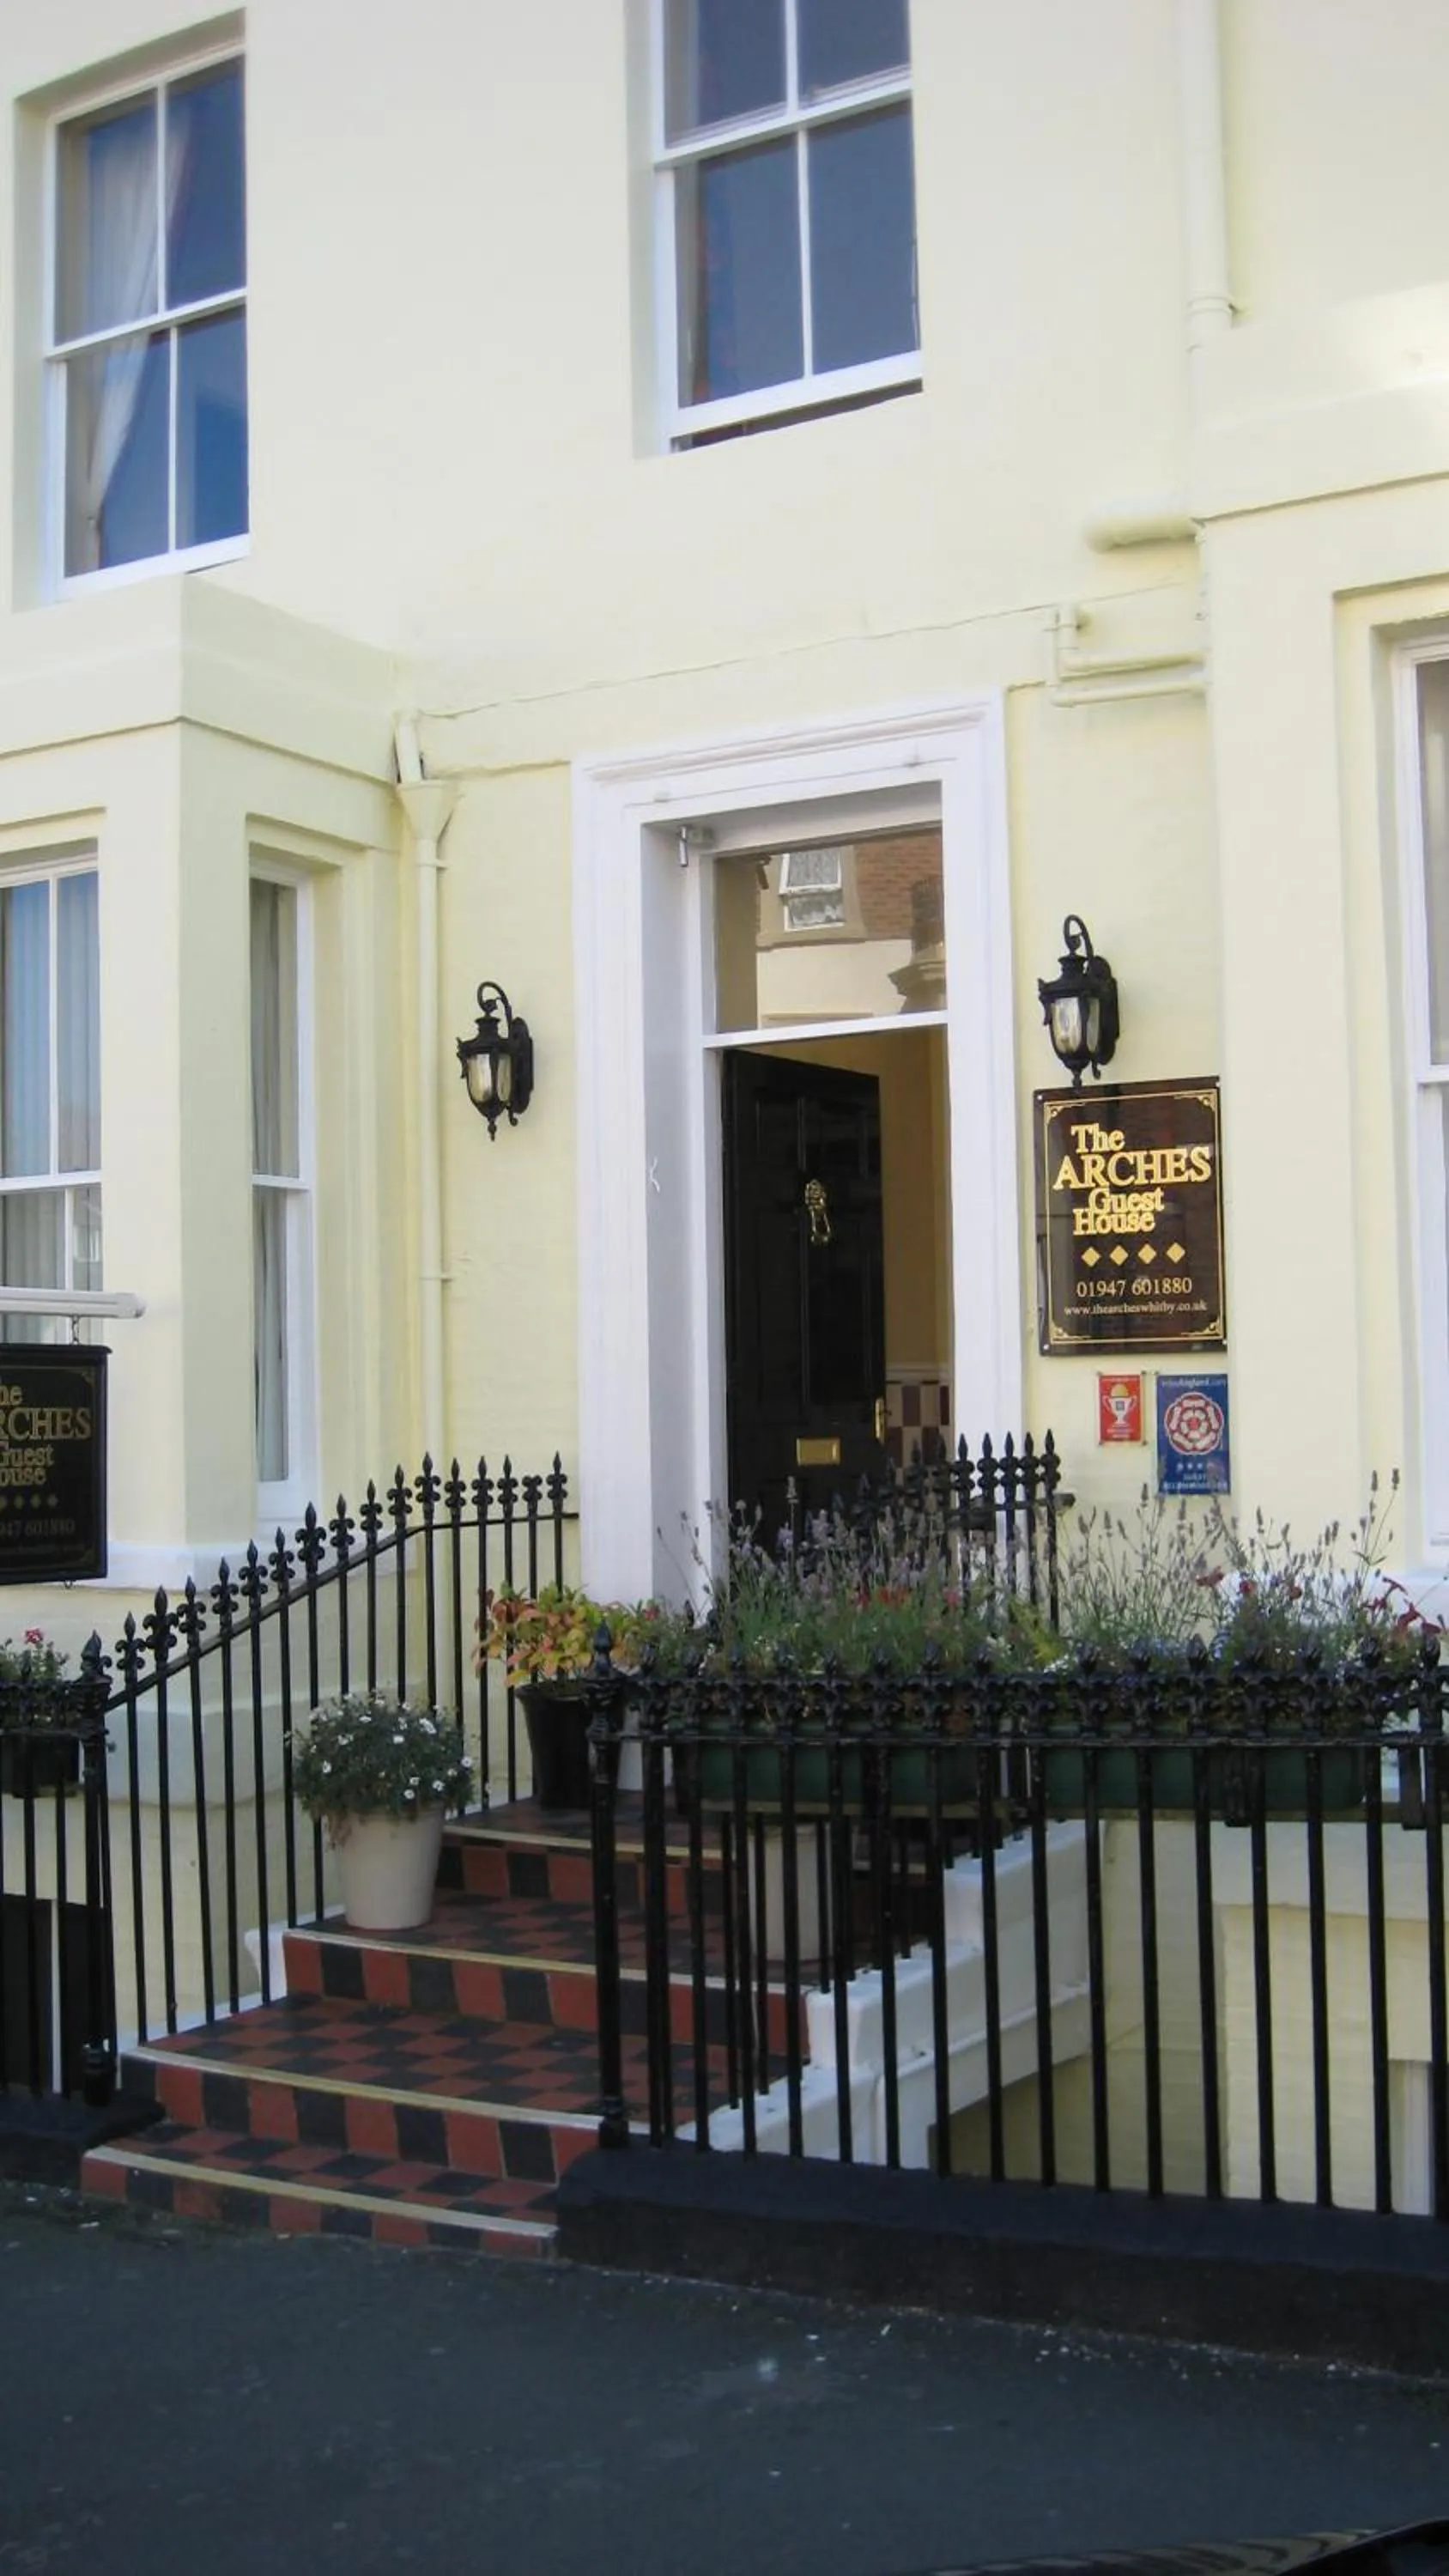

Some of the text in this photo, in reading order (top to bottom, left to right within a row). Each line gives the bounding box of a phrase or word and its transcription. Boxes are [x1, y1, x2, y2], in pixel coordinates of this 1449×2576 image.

[1071, 1123, 1125, 1153] The
[1052, 1145, 1212, 1190] ARCHES
[1088, 1187, 1165, 1214] Guest
[1073, 1207, 1156, 1236] House
[1076, 1277, 1192, 1297] 01947 601880
[0, 1380, 22, 1405] he
[0, 1406, 92, 1441] CHES
[0, 1467, 46, 1486] ouse
